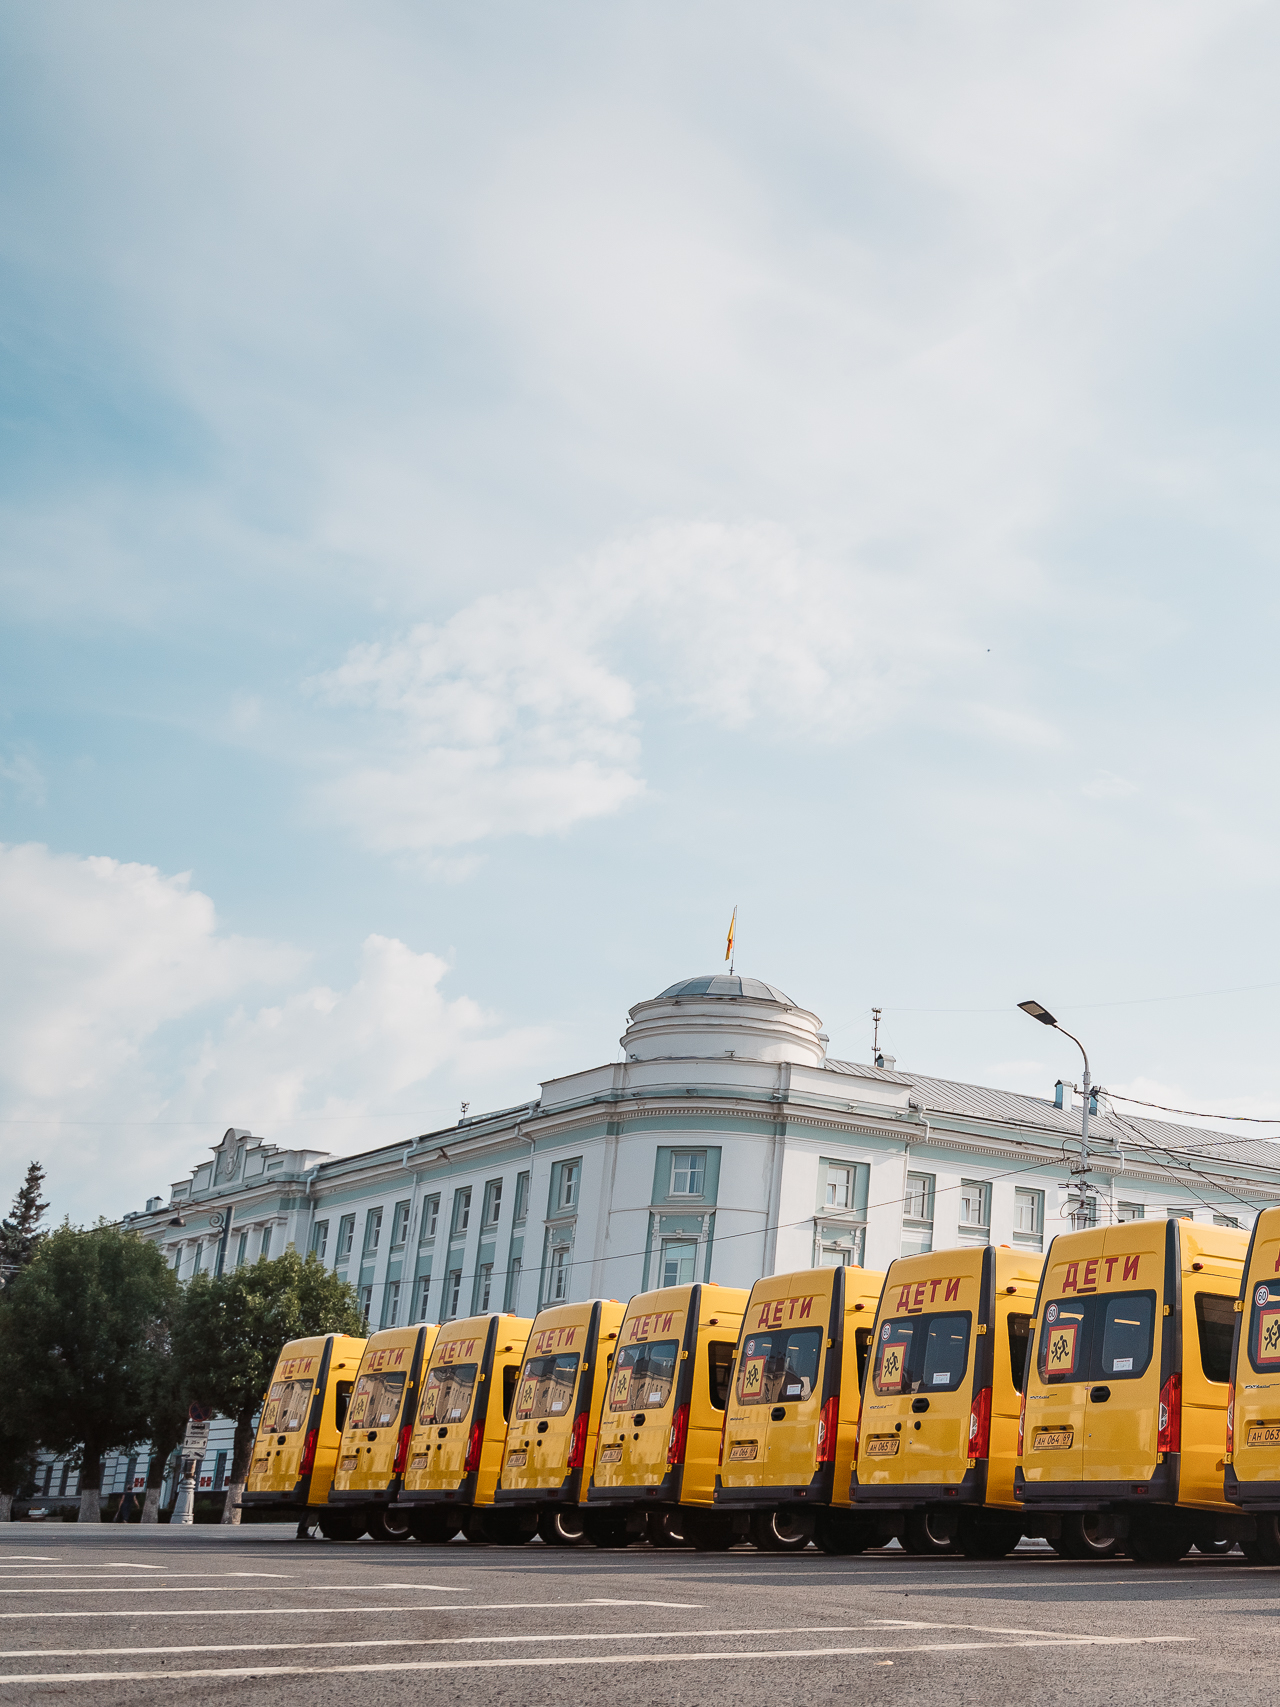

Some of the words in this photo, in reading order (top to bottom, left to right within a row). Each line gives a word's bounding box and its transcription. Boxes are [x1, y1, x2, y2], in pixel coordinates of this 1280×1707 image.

[1061, 1255, 1141, 1293] ДЕТИ
[896, 1278, 961, 1312] ДЕТИ
[1257, 1290, 1267, 1301] 60
[757, 1296, 814, 1328] ДЕТИ
[1048, 1307, 1056, 1315] 60
[629, 1312, 674, 1341] ДЕТИ
[438, 1339, 476, 1363] ДЕТИ
[535, 1327, 576, 1354] ДЕТИ
[280, 1357, 313, 1377] ДЕТИ
[367, 1348, 405, 1371] ДЕТИ
[878, 1441, 889, 1451] 065
[1047, 1434, 1060, 1445] 064
[1252, 1432, 1263, 1441] АН
[1265, 1429, 1280, 1441] 063
